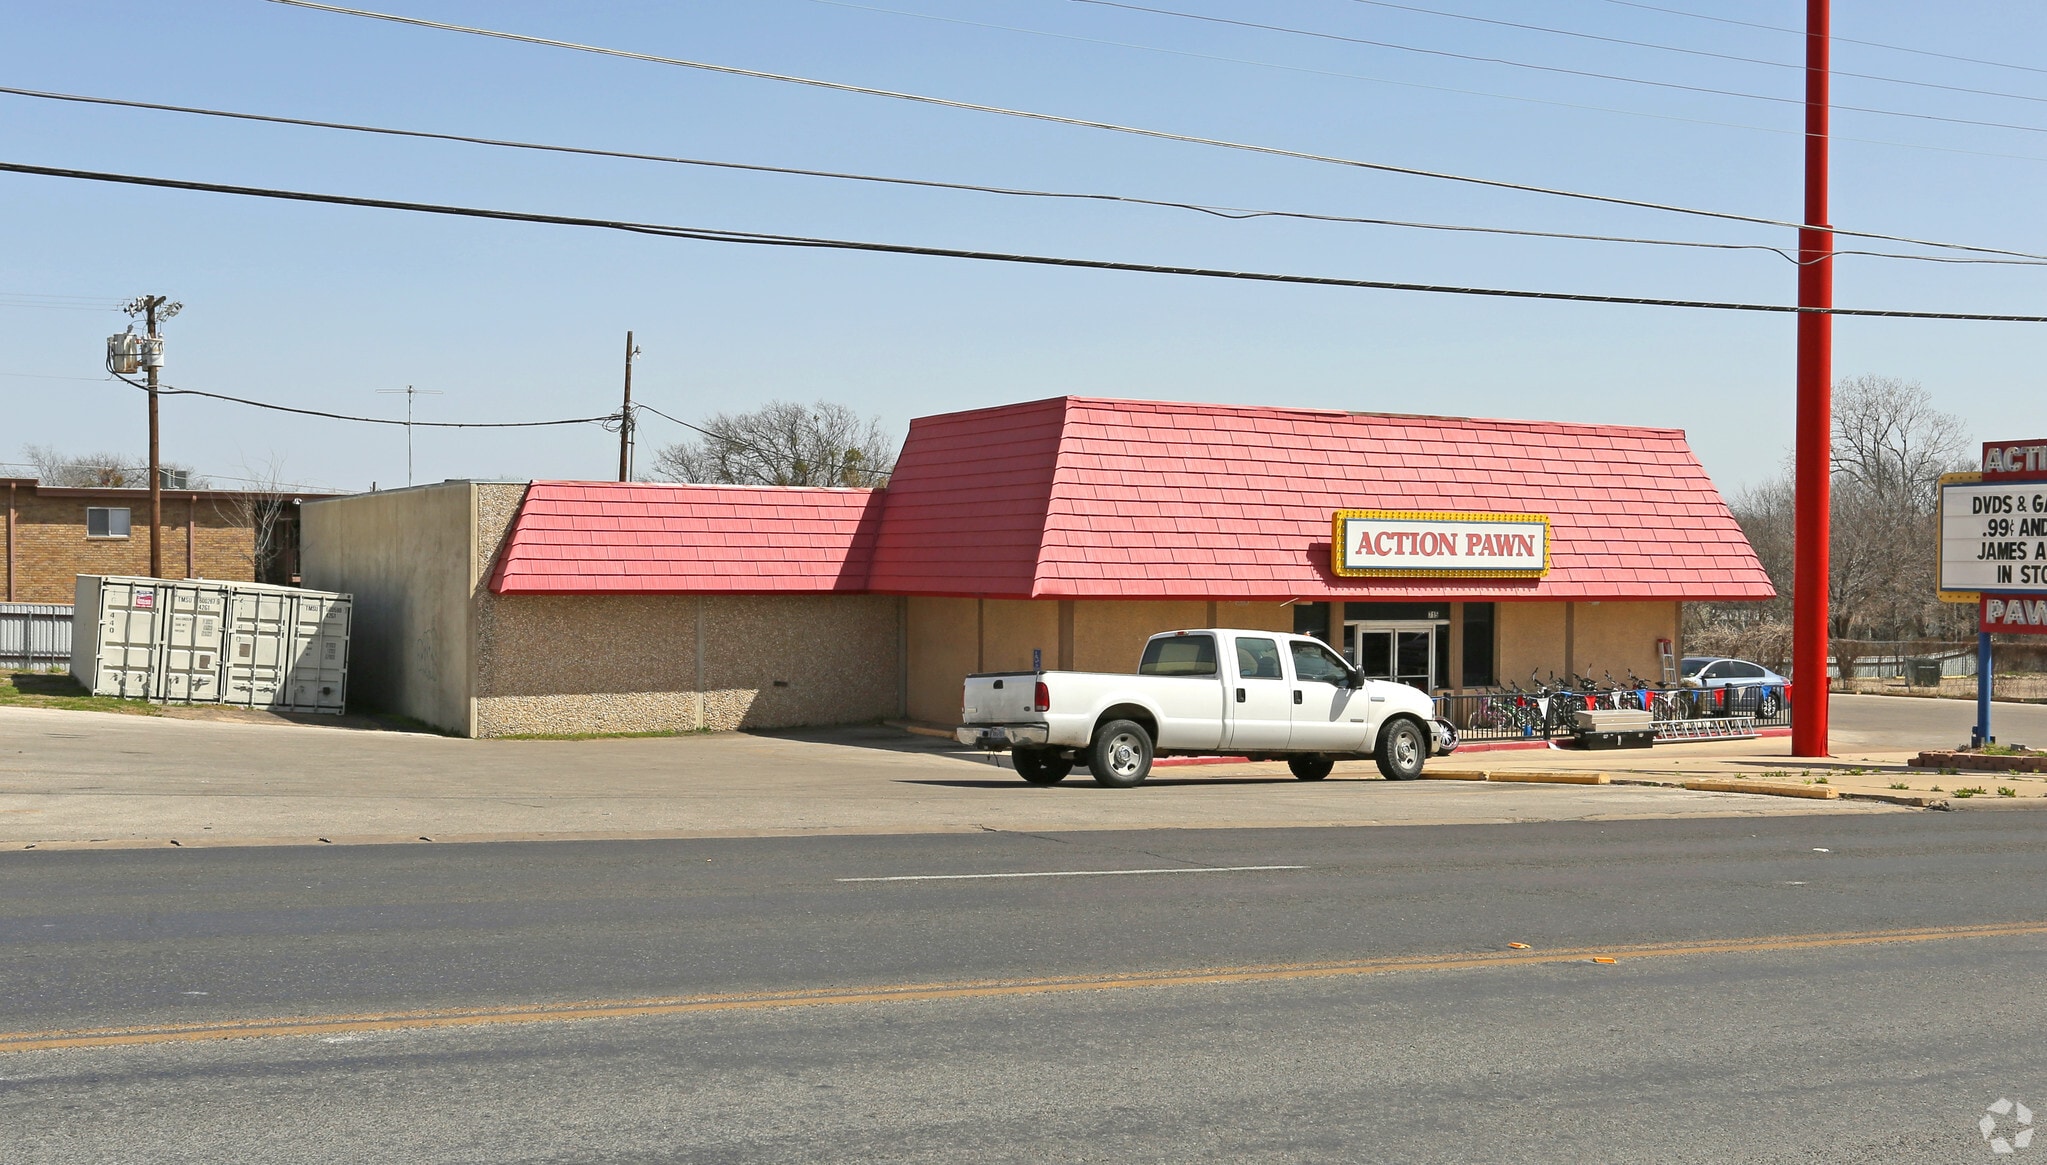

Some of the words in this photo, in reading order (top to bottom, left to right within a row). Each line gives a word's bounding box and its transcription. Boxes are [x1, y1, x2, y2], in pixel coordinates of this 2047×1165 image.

[1973, 495, 2013, 514] DVDS
[2017, 495, 2027, 513] &
[2019, 518, 2047, 537] AND
[1355, 531, 1458, 557] ACTION
[1465, 533, 1535, 557] PAWN
[1977, 541, 2027, 560] JAMES
[2035, 541, 2047, 560] A
[1998, 565, 2012, 583] IN
[1985, 599, 2047, 625] PAW
